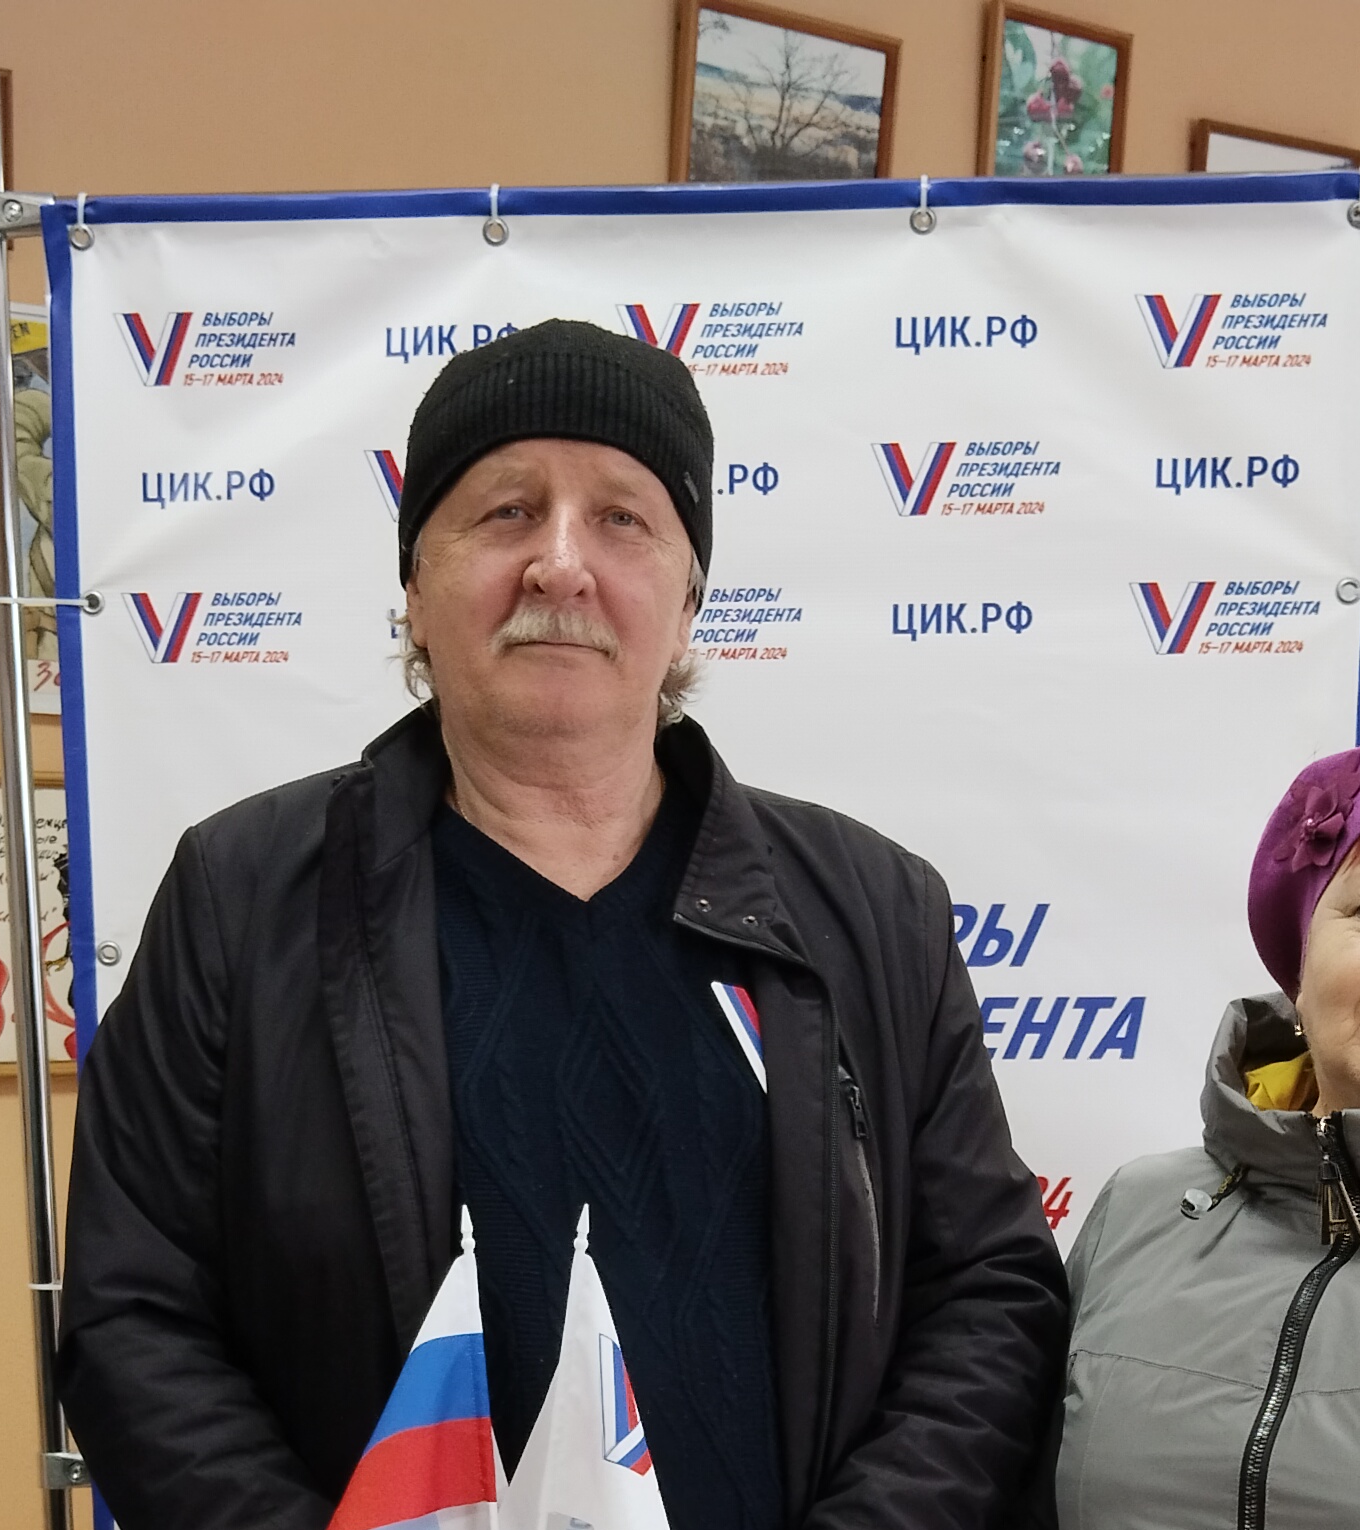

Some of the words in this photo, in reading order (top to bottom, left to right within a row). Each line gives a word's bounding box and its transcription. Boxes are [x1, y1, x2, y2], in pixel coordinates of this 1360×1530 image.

[1230, 293, 1307, 308] ВЫБОРЫ
[708, 302, 782, 318] ВЫБОРЫ
[202, 312, 273, 327] ВЫБОРЫ
[1221, 313, 1328, 330] ПРЕЗИДЕНТА
[700, 322, 804, 339] ПРЕЗИДЕНТА
[896, 314, 1038, 355] ЦИК.РФ
[195, 332, 296, 349] ПРЕЗИДЕНТА
[1212, 335, 1282, 350] РОССИИ
[691, 344, 759, 359] РОССИИ
[188, 354, 253, 368] РОССИИ
[1240, 354, 1280, 367] МАРТА
[1282, 354, 1312, 367] 2024
[719, 363, 758, 376] МАРТА
[760, 362, 789, 375] 2024
[215, 373, 253, 386] МАРТА
[256, 373, 284, 386] 2024
[965, 441, 1040, 457] ВЫБОРЫ
[956, 461, 1061, 478] ПРЕЗИДЕНТА
[1156, 454, 1300, 495] ЦИК.РФ
[142, 468, 275, 509] ЦИК.РФ
[947, 483, 1015, 498] РОССИИ
[975, 502, 1013, 515] МАРТА
[1016, 501, 1045, 515] 2024
[708, 588, 782, 603] ВЫБОРЫ
[1223, 581, 1300, 596] ВЫБОРЫ
[211, 592, 282, 607] ВЫБОРЫ
[700, 608, 802, 624] ПРЕЗИДЕНТА
[1214, 601, 1321, 617] ПРЕЗИДЕНТА
[202, 612, 302, 628] ПРЕЗИДЕНТА
[892, 600, 1033, 642] ЦИК.РФ
[692, 629, 758, 643] РОССИИ
[1205, 622, 1274, 637] РОССИИ
[196, 632, 260, 646] РОССИИ
[718, 648, 758, 660] МАРТА
[759, 647, 787, 660] 2024
[1232, 641, 1273, 654] МАРТА
[1274, 640, 1304, 654] 2024
[222, 651, 260, 663] МАРТА
[262, 651, 290, 663] 2024
